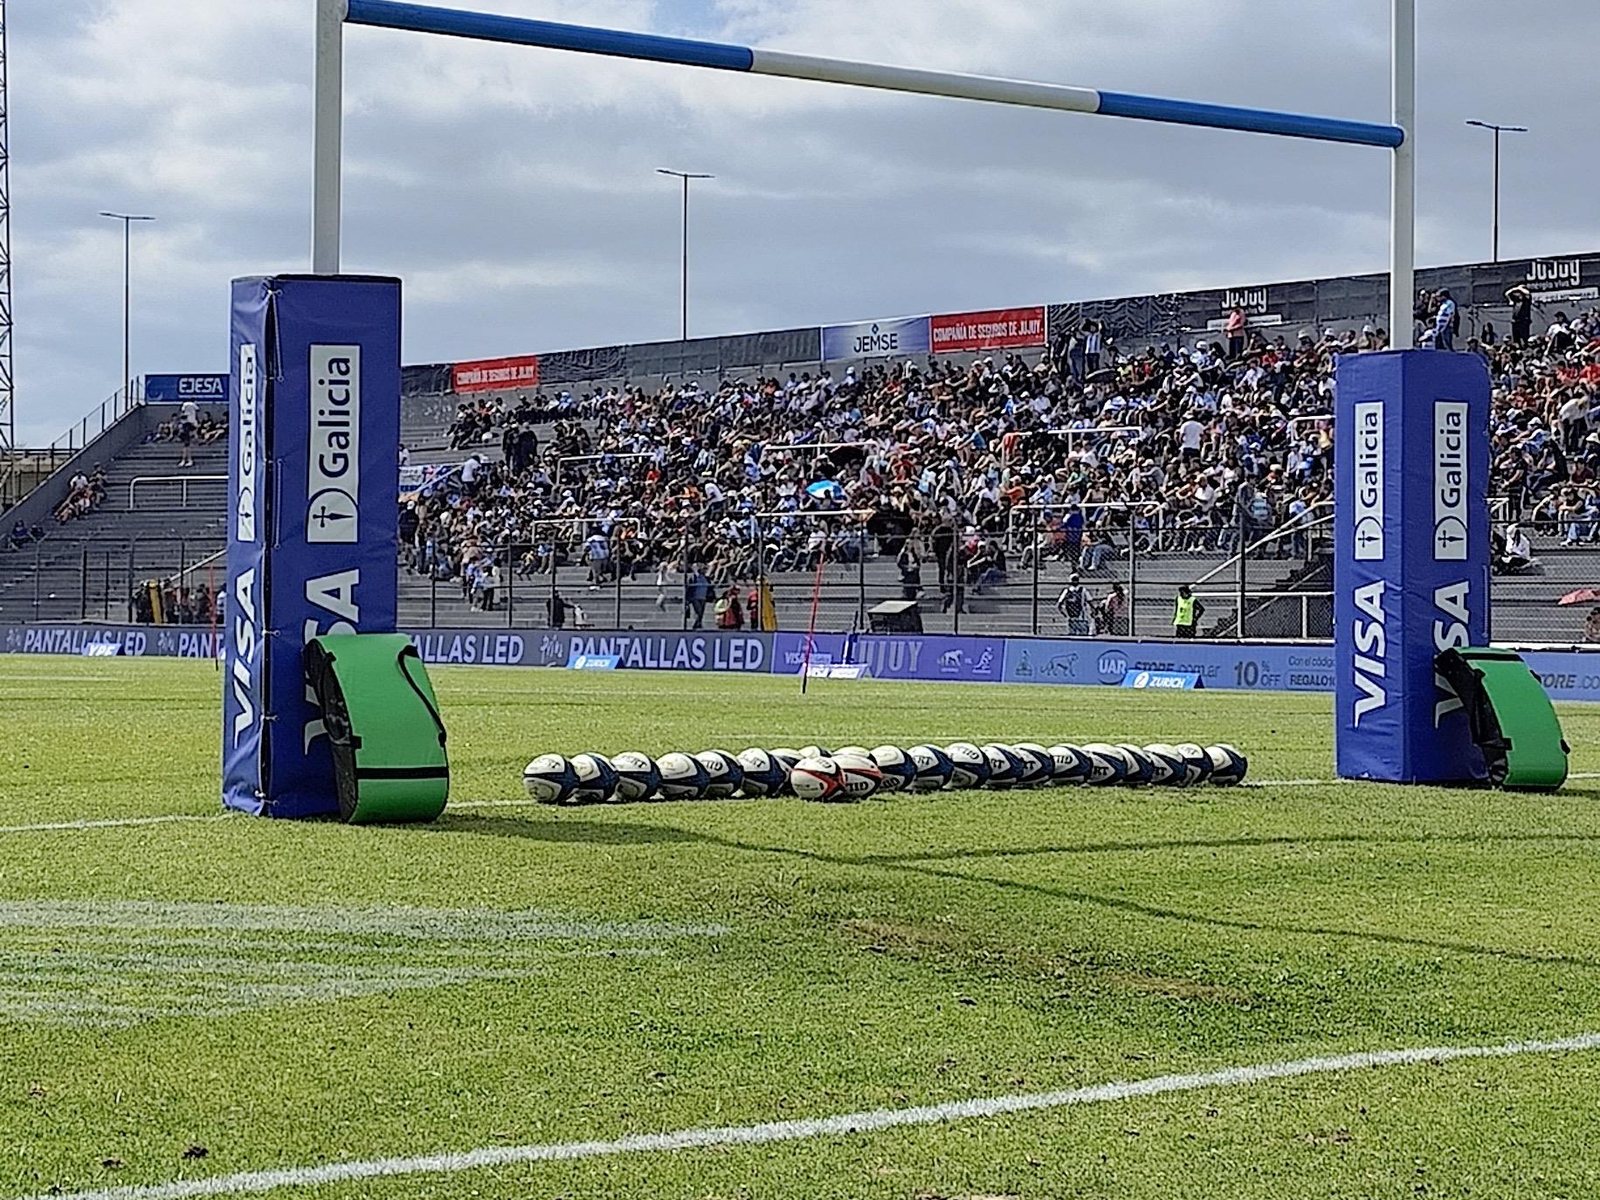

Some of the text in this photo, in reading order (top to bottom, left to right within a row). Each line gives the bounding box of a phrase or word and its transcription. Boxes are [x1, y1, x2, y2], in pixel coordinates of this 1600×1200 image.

[853, 333, 898, 353] JEMSE
[318, 357, 350, 478] Galicia
[1360, 412, 1378, 508] Galicia
[1440, 412, 1461, 508] Galicia
[233, 568, 255, 749] VISA
[481, 634, 524, 664] LED
[569, 636, 764, 670] PANTALLAS LED
[1099, 659, 1127, 675] UAR
[1234, 661, 1259, 686] 10
[1260, 674, 1281, 687] OFF
[1354, 580, 1386, 728] VISA
[1434, 581, 1469, 729] VSA
